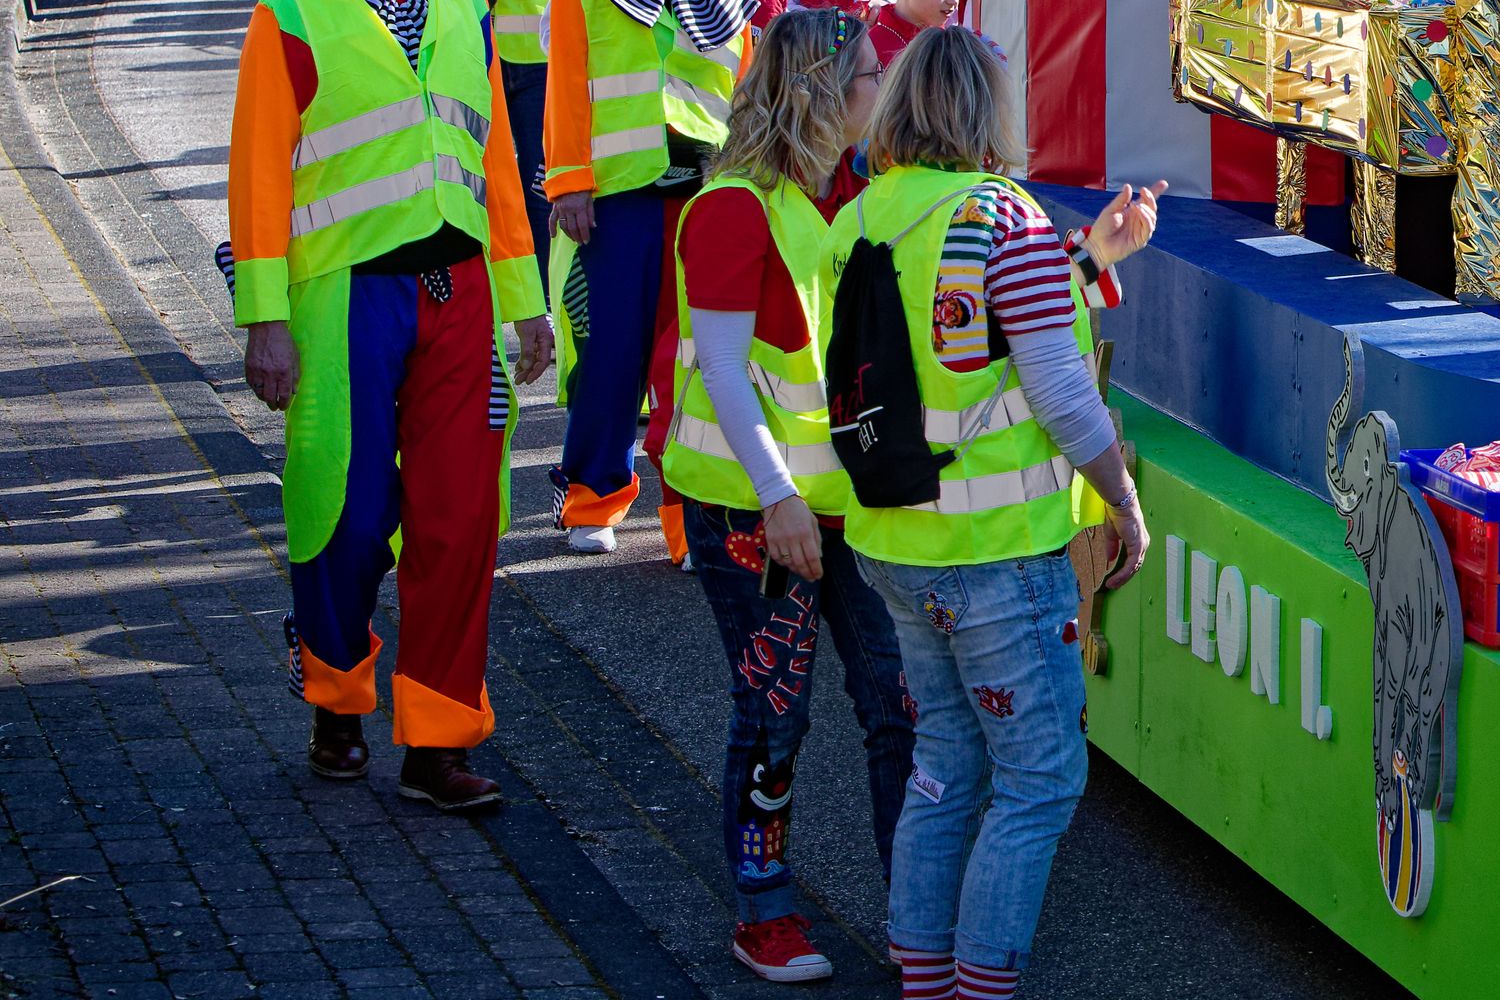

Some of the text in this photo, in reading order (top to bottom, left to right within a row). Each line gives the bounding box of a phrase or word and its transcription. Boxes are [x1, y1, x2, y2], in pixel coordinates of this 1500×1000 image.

[664, 166, 697, 177] NIKE
[738, 582, 814, 690] KÖLLE
[1165, 534, 1281, 705] LEON
